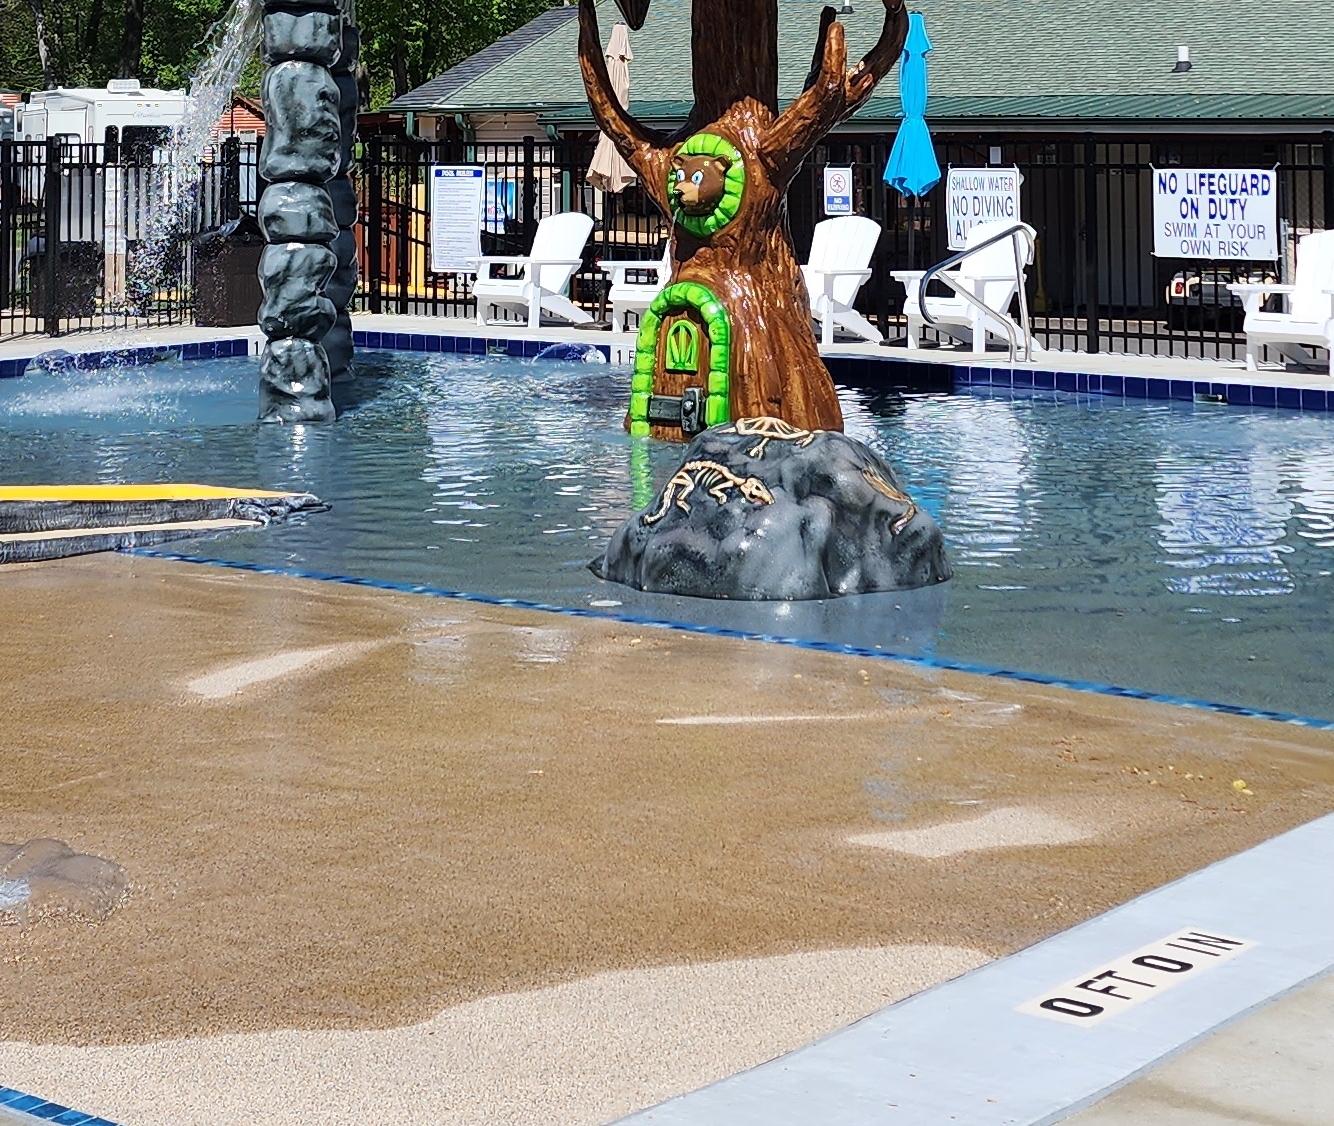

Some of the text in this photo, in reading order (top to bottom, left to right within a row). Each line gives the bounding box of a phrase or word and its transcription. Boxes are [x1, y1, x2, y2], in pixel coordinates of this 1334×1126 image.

[952, 177, 1013, 191] SHALLOW WATER
[1158, 173, 1270, 196] NO LIFEGUARD
[953, 196, 1013, 217] NO DIVING
[1179, 197, 1248, 220] ON DUTY
[1164, 222, 1266, 240] SWIM AT YOUR
[1180, 240, 1249, 257] OWN RISK
[1074, 970, 1157, 1000] FT
[1165, 932, 1245, 957] IN
